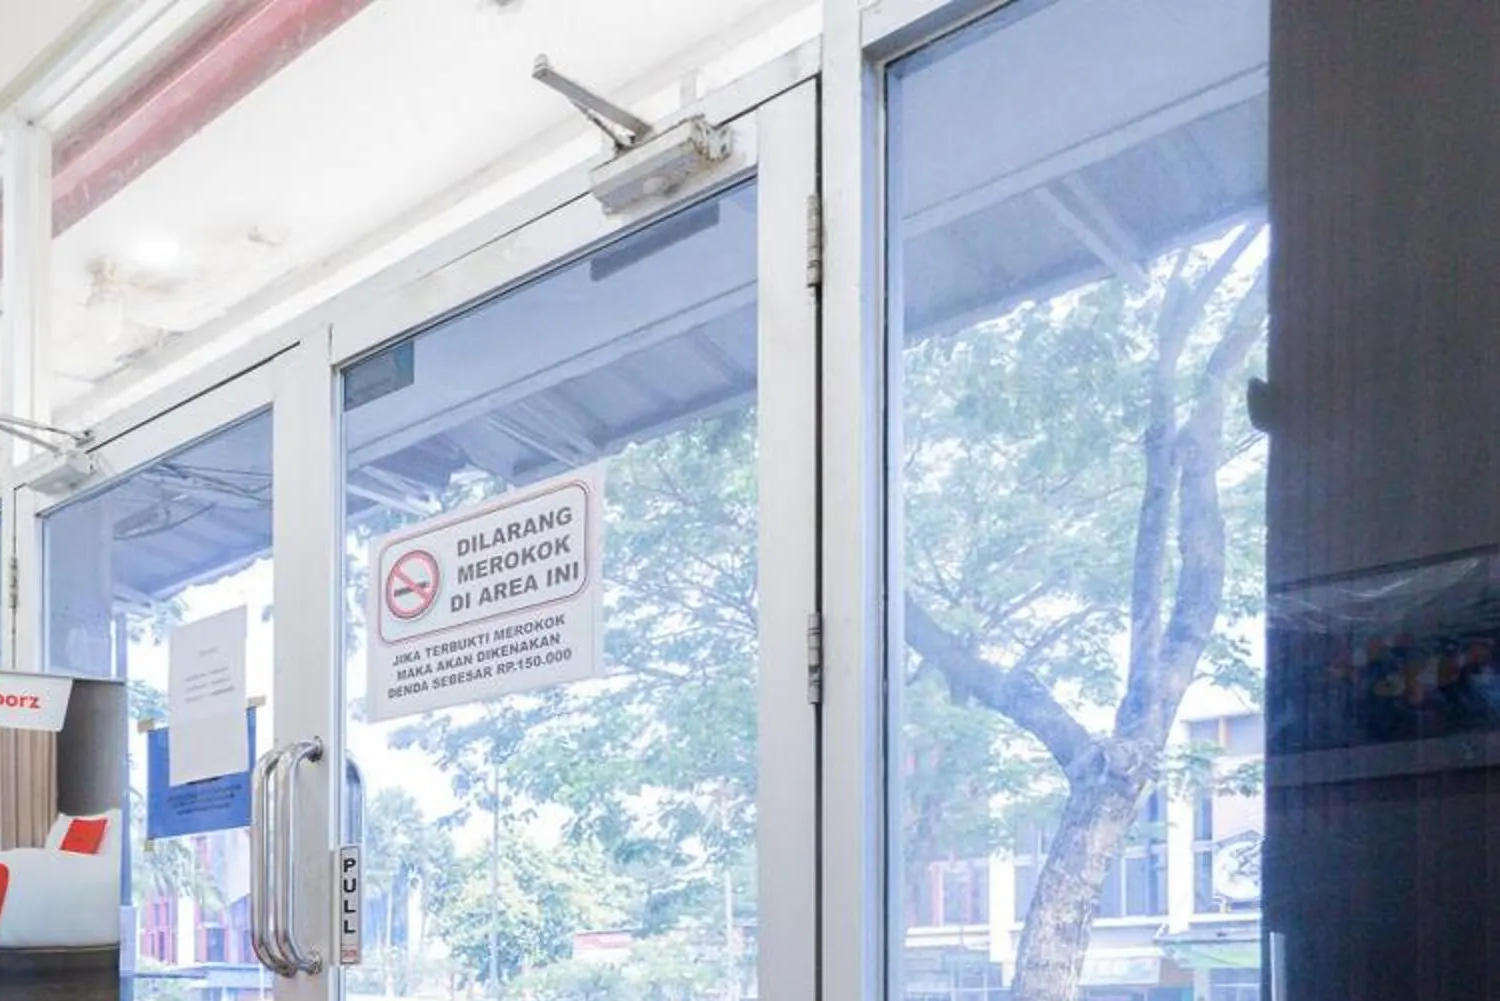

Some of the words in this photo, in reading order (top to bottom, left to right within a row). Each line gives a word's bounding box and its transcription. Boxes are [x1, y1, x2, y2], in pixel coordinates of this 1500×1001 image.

[456, 506, 573, 557] DILARANG
[457, 535, 572, 584] MEROKOK
[451, 594, 471, 613] DI
[479, 575, 539, 606] AREA
[546, 561, 580, 588] INI
[392, 652, 421, 667] JIKA
[425, 634, 490, 659] TERBUKTI
[493, 614, 565, 642] MEROKOK
[396, 664, 433, 680] MAKA
[437, 655, 473, 672] AKAN
[476, 633, 561, 663] DIKENAKAN
[388, 681, 429, 699] DENDA
[432, 666, 493, 690] SEBESAR
[497, 648, 573, 675] RP.150.000
[343, 858, 357, 935] PULL
